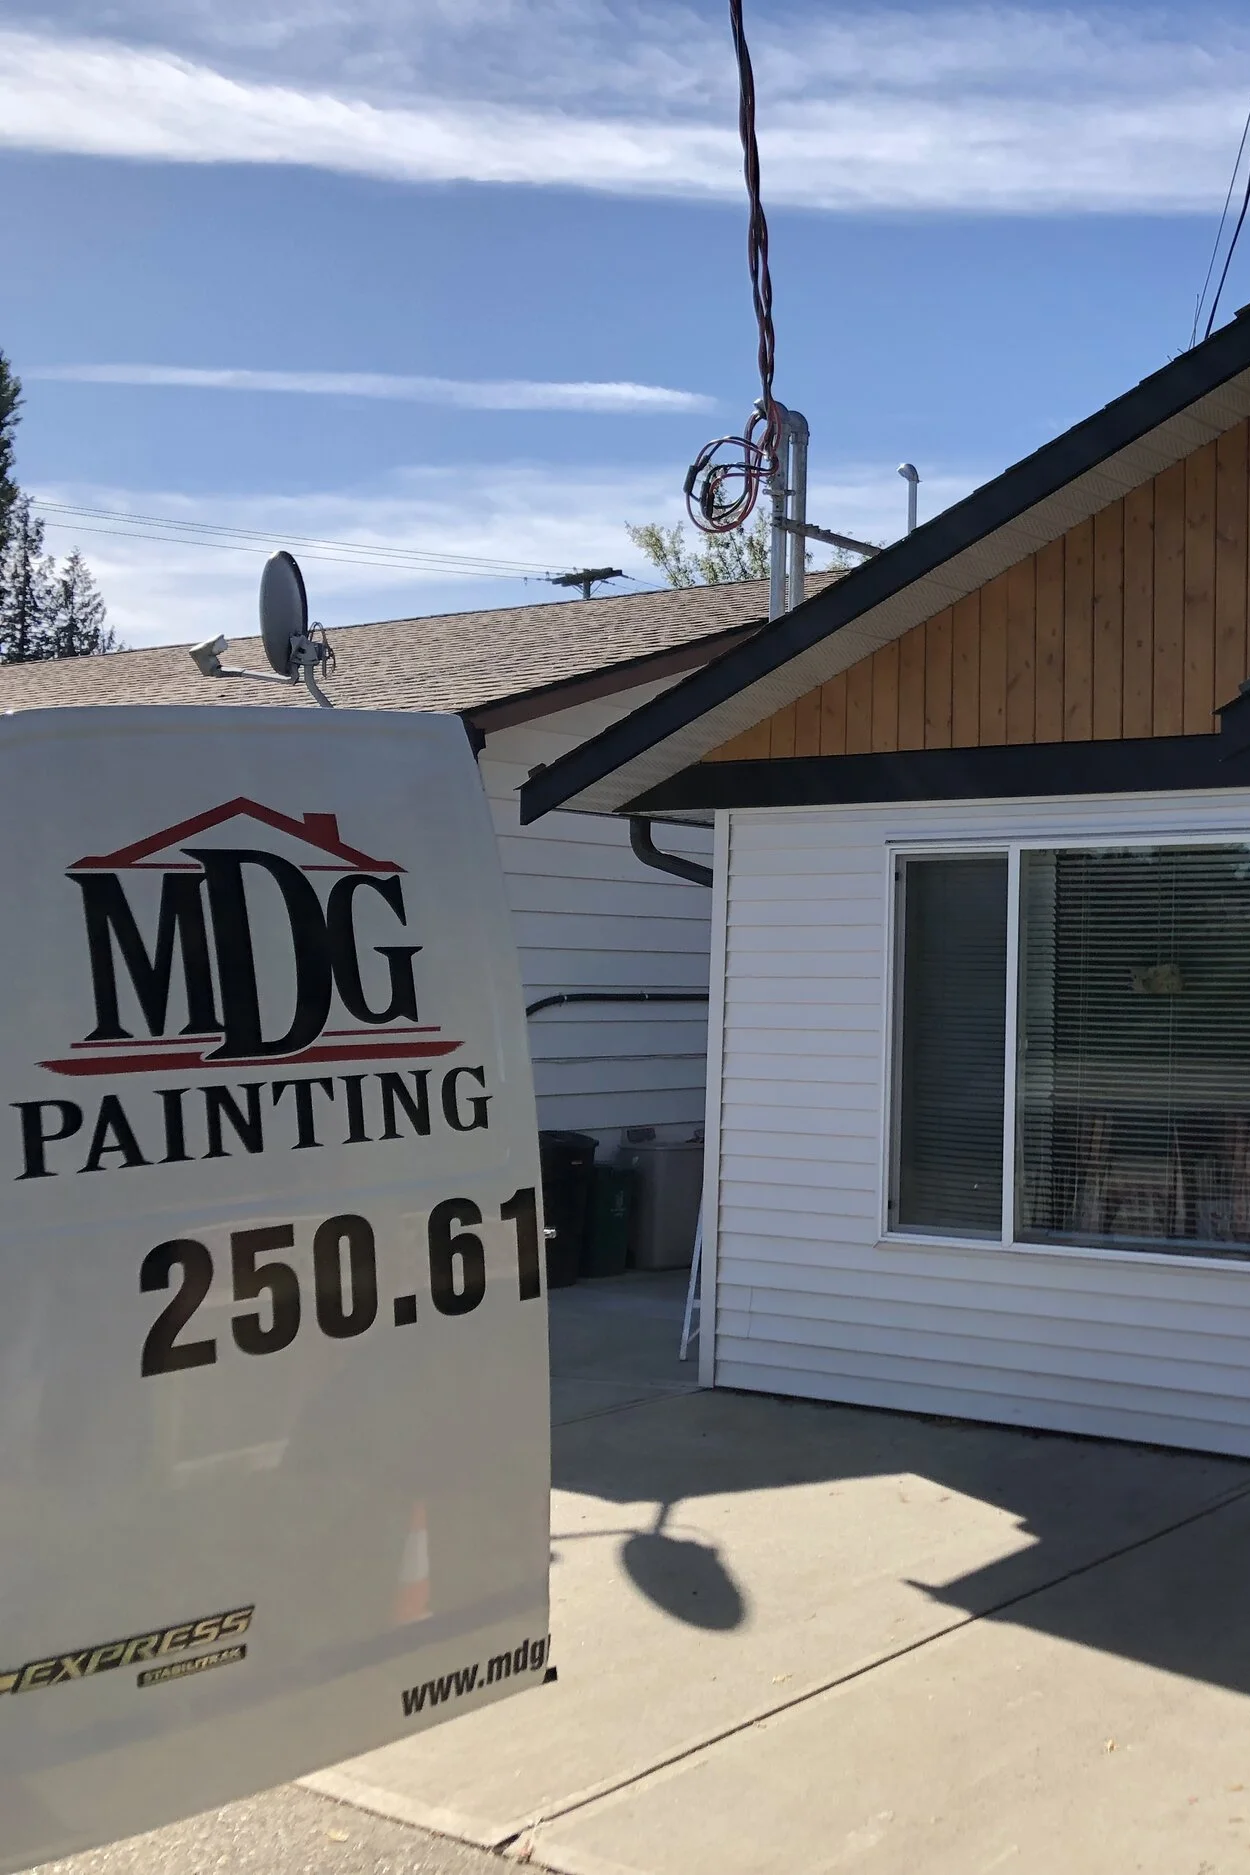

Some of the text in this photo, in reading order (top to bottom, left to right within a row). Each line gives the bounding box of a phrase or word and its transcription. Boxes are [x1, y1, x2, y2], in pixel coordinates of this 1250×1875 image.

[65, 848, 423, 1060] MDG
[10, 1065, 493, 1180] PAINTING
[140, 1187, 541, 1378] 250.61
[14, 1607, 252, 1693] EXPRESS
[402, 1634, 551, 1716] www.mdg
